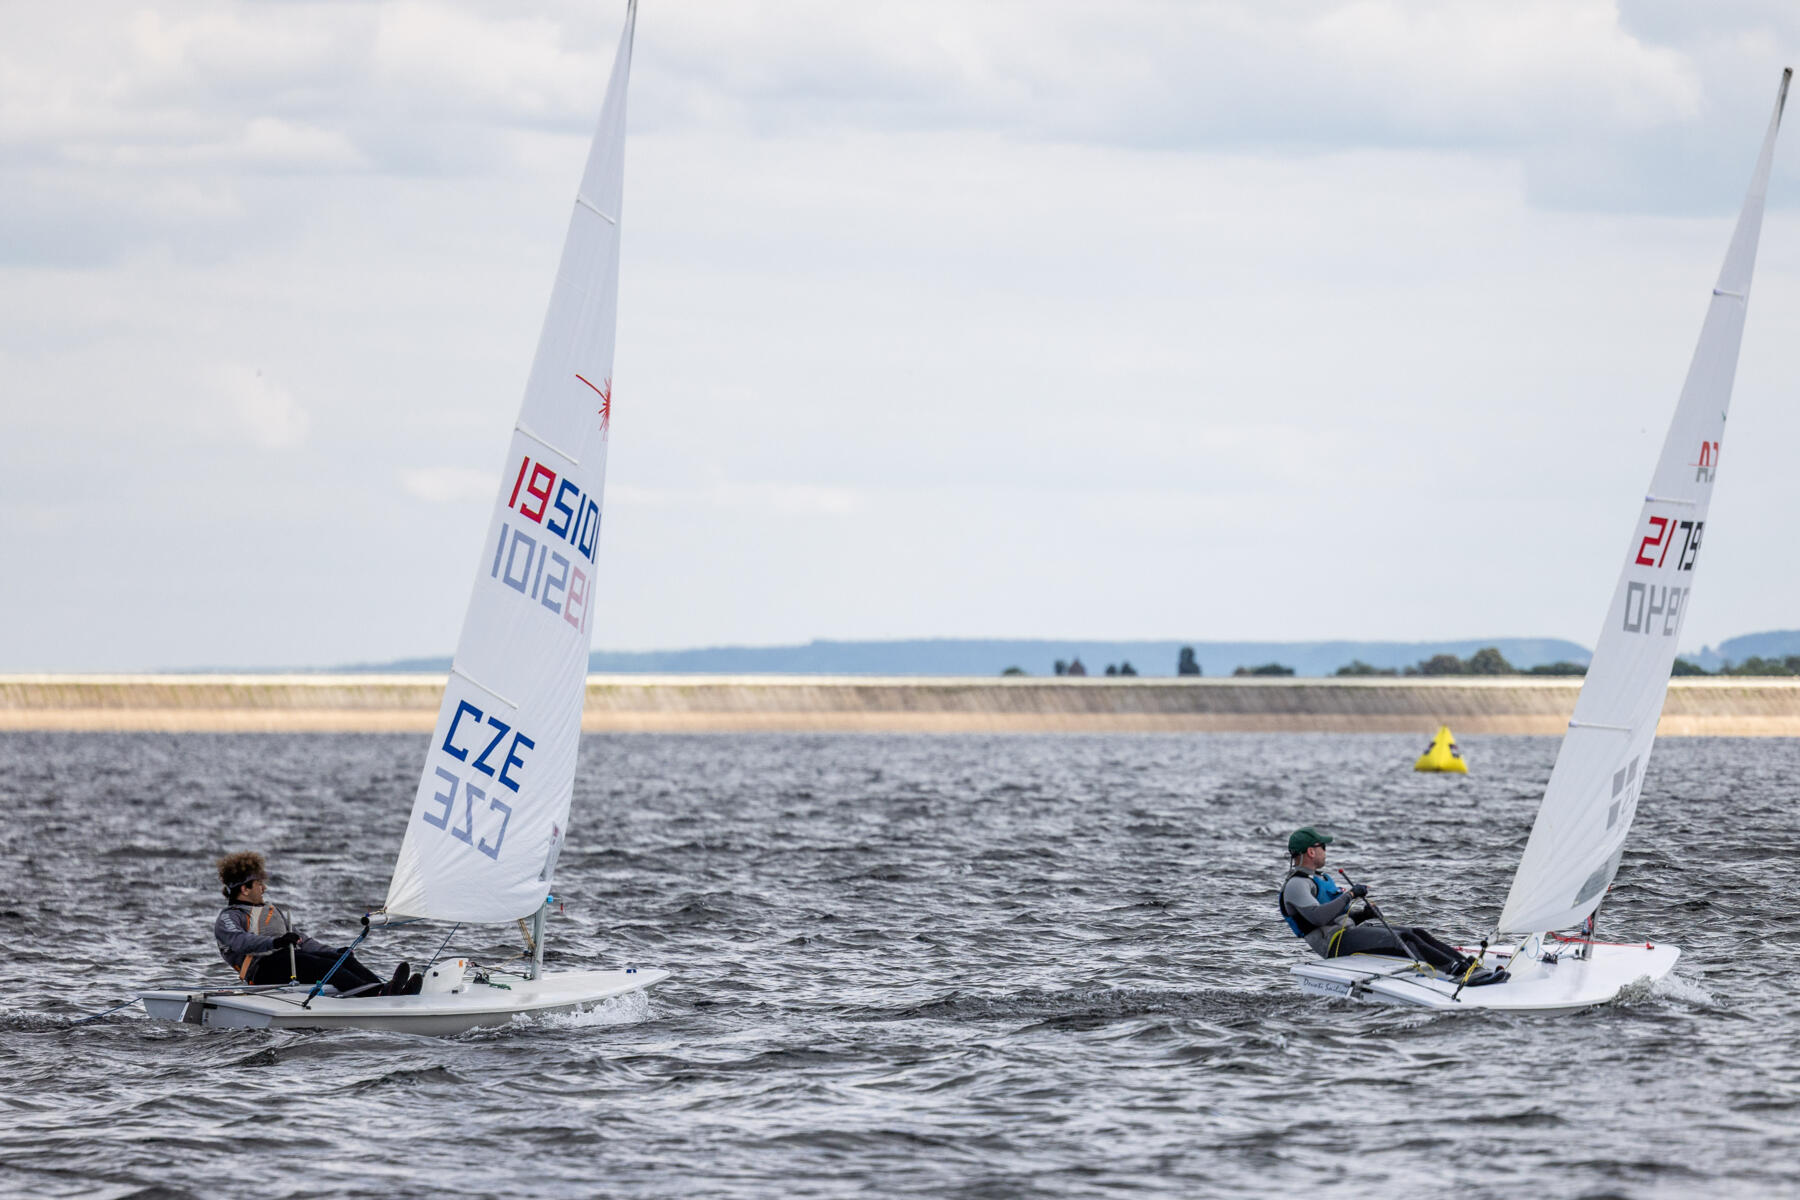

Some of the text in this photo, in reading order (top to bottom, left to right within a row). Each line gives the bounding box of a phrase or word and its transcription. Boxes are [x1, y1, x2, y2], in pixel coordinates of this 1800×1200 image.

[508, 456, 601, 565] 195101
[1635, 516, 1704, 571] 2179
[442, 699, 535, 793] CZE
